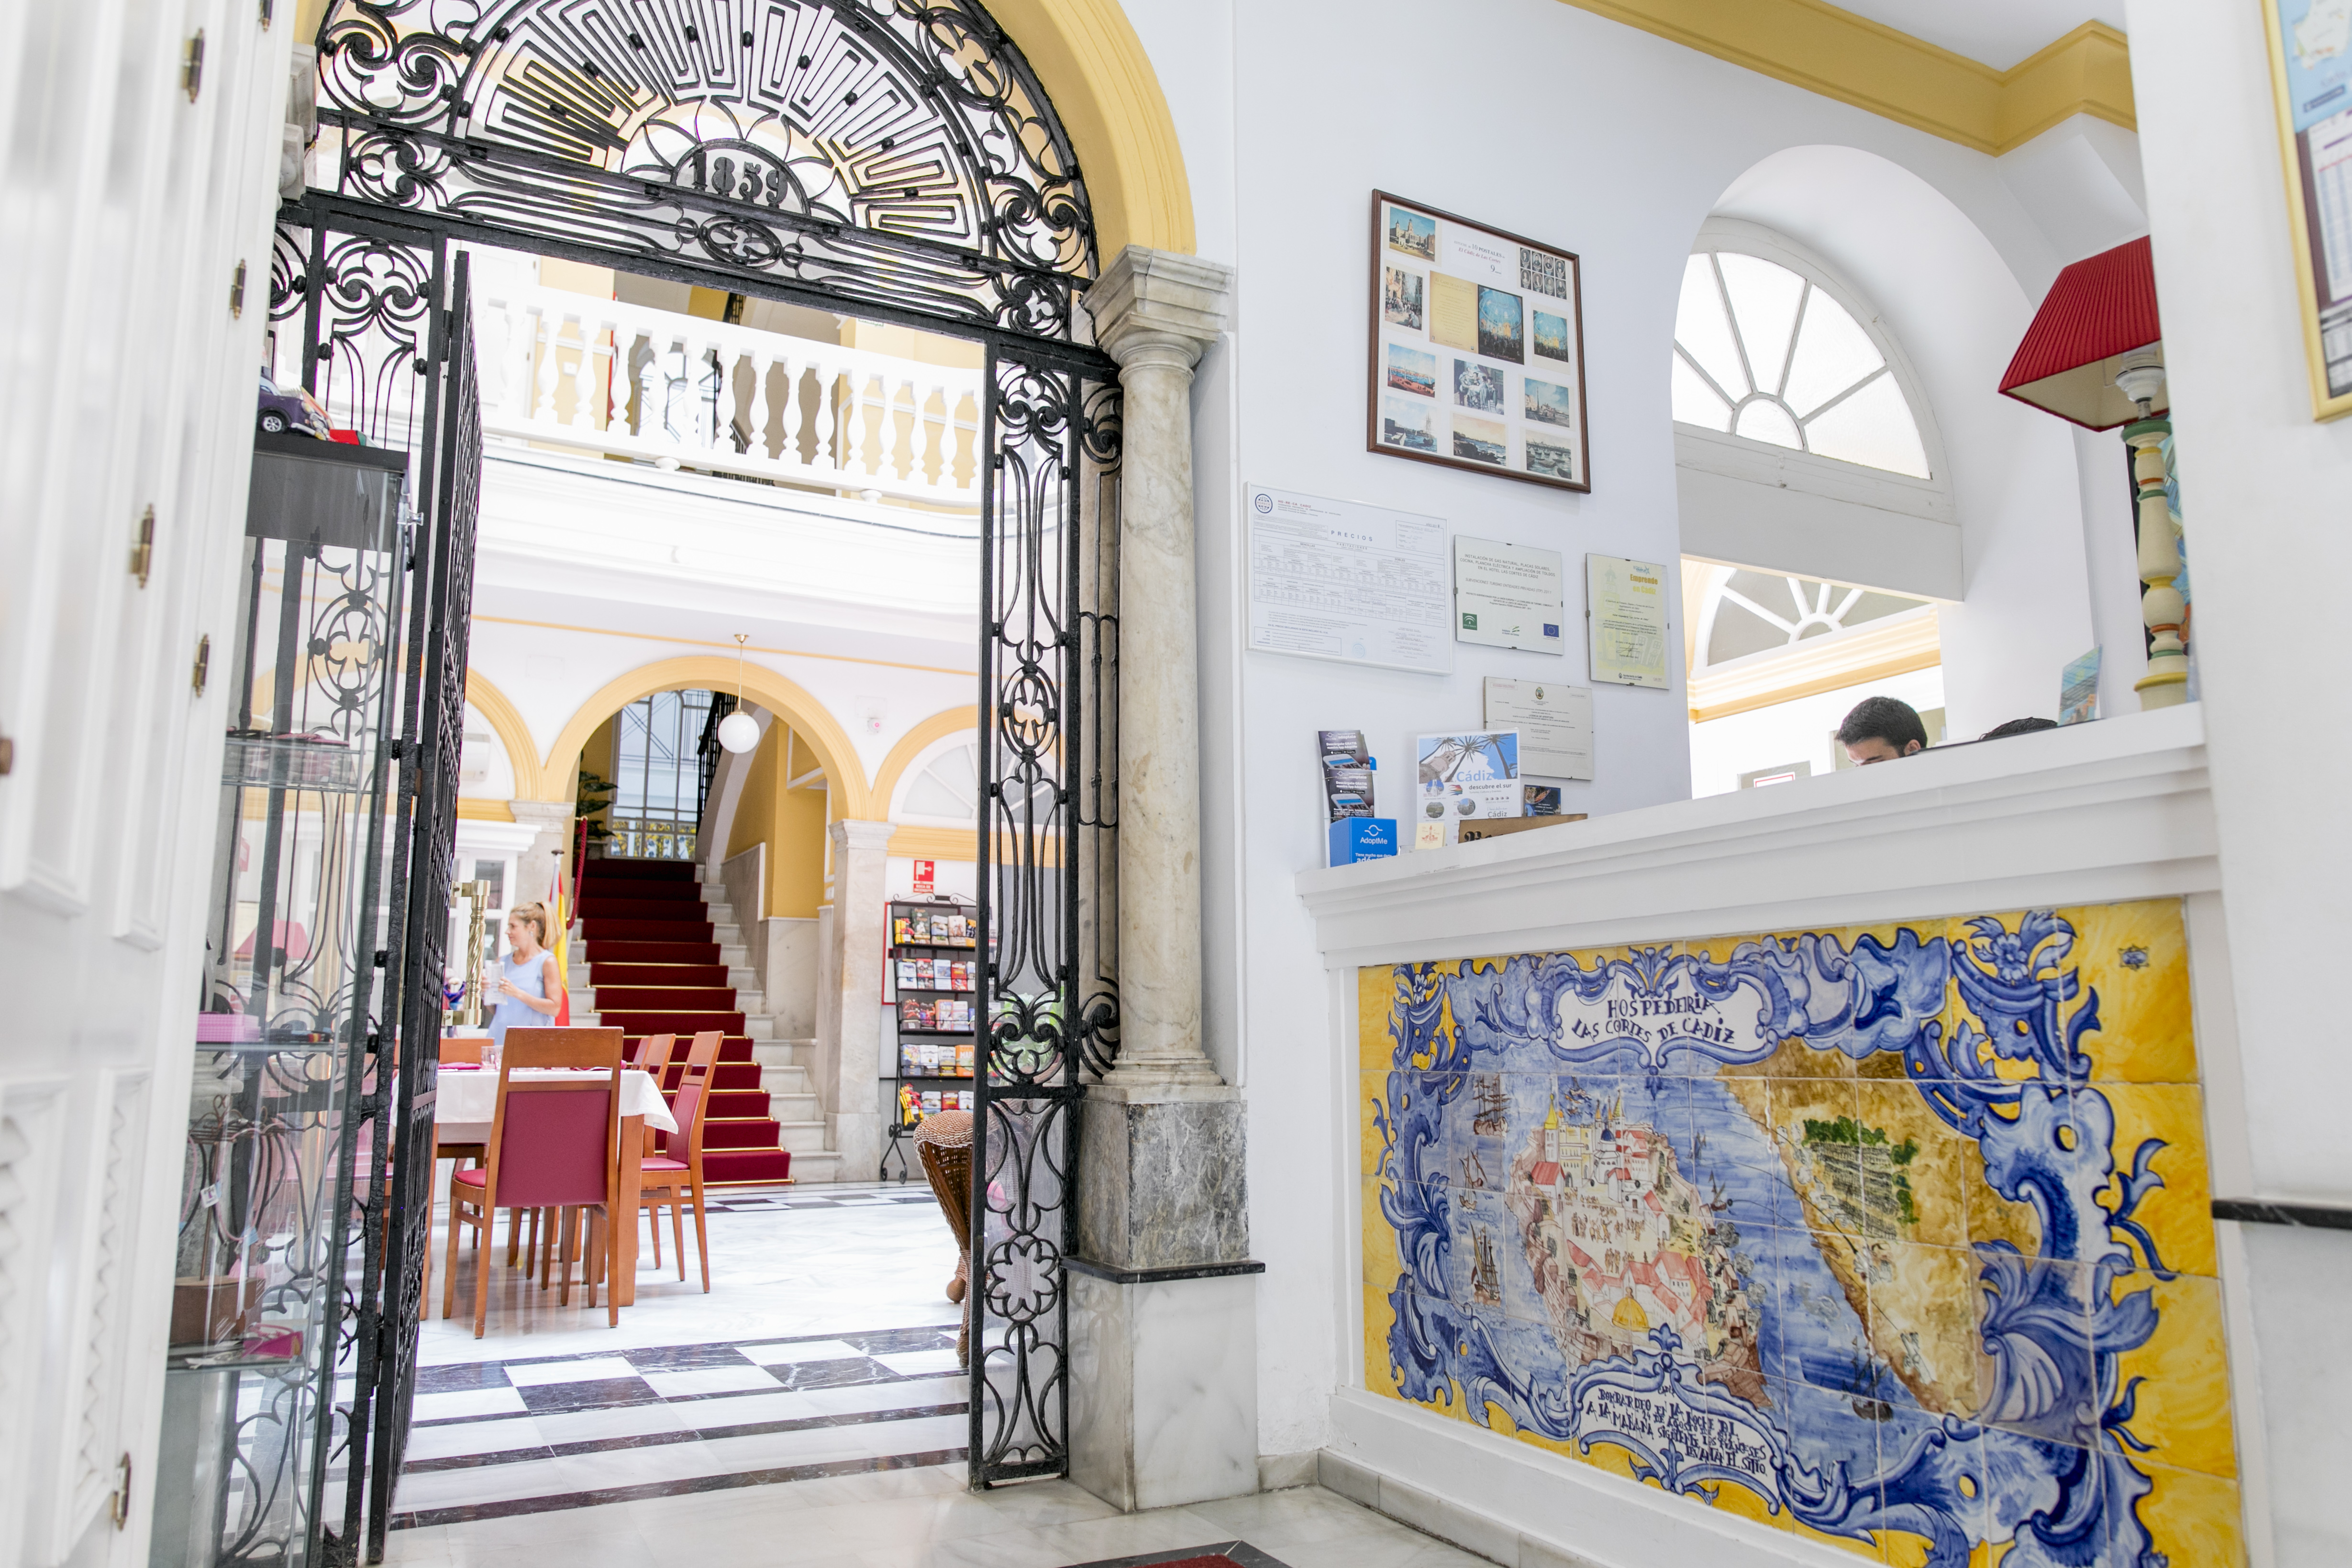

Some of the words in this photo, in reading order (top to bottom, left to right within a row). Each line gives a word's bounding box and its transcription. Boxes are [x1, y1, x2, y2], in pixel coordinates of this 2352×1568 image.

[689, 150, 788, 204] 1859
[1464, 248, 1475, 256] Cádiz
[1478, 246, 1502, 258] POSTALES
[1490, 264, 1495, 272] 9
[1331, 530, 1373, 542] PRECIOS
[1630, 574, 1658, 585] Emprende
[1641, 586, 1656, 595] Cádiz
[1456, 770, 1492, 782] Cádiz
[1360, 837, 1387, 845] AdoptMe
[1607, 992, 1721, 1019] HOSPEDERIA
[1571, 1018, 1599, 1043] LAS
[1606, 1018, 1652, 1043] CORTES
[1657, 1022, 1678, 1043] DE
[1682, 1017, 1735, 1045] CADIZ
[1598, 1387, 1652, 1412] BOMBARDEO
[1653, 1401, 1667, 1416] EN
[1669, 1402, 1685, 1421] LA
[1586, 1401, 1598, 1422] A
[1598, 1402, 1612, 1424] LA
[1613, 1411, 1654, 1440] MAÑANA
[1653, 1413, 1665, 1423] DE
[1667, 1415, 1698, 1432] AGOSTO
[1725, 1450, 1741, 1469] EL
